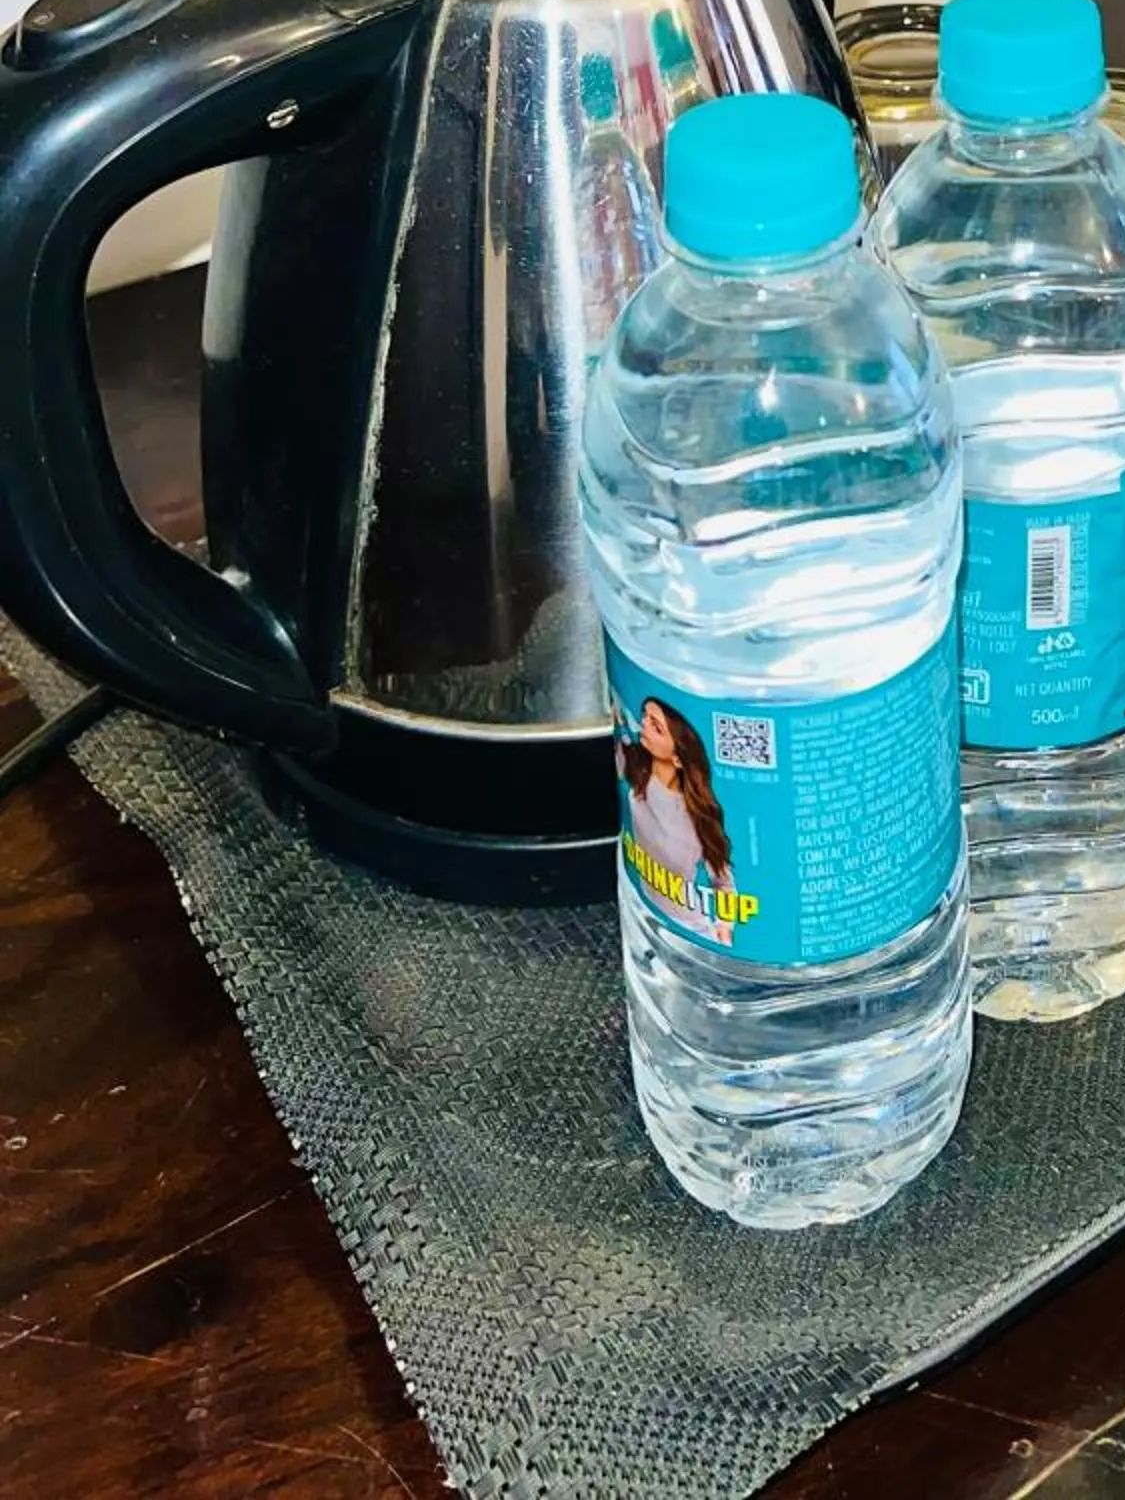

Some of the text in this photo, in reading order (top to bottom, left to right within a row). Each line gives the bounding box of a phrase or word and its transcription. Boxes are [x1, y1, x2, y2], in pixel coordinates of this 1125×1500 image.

[1040, 676, 1093, 696] QUANTITY
[622, 831, 687, 907] DRINK
[715, 890, 759, 924] UP
